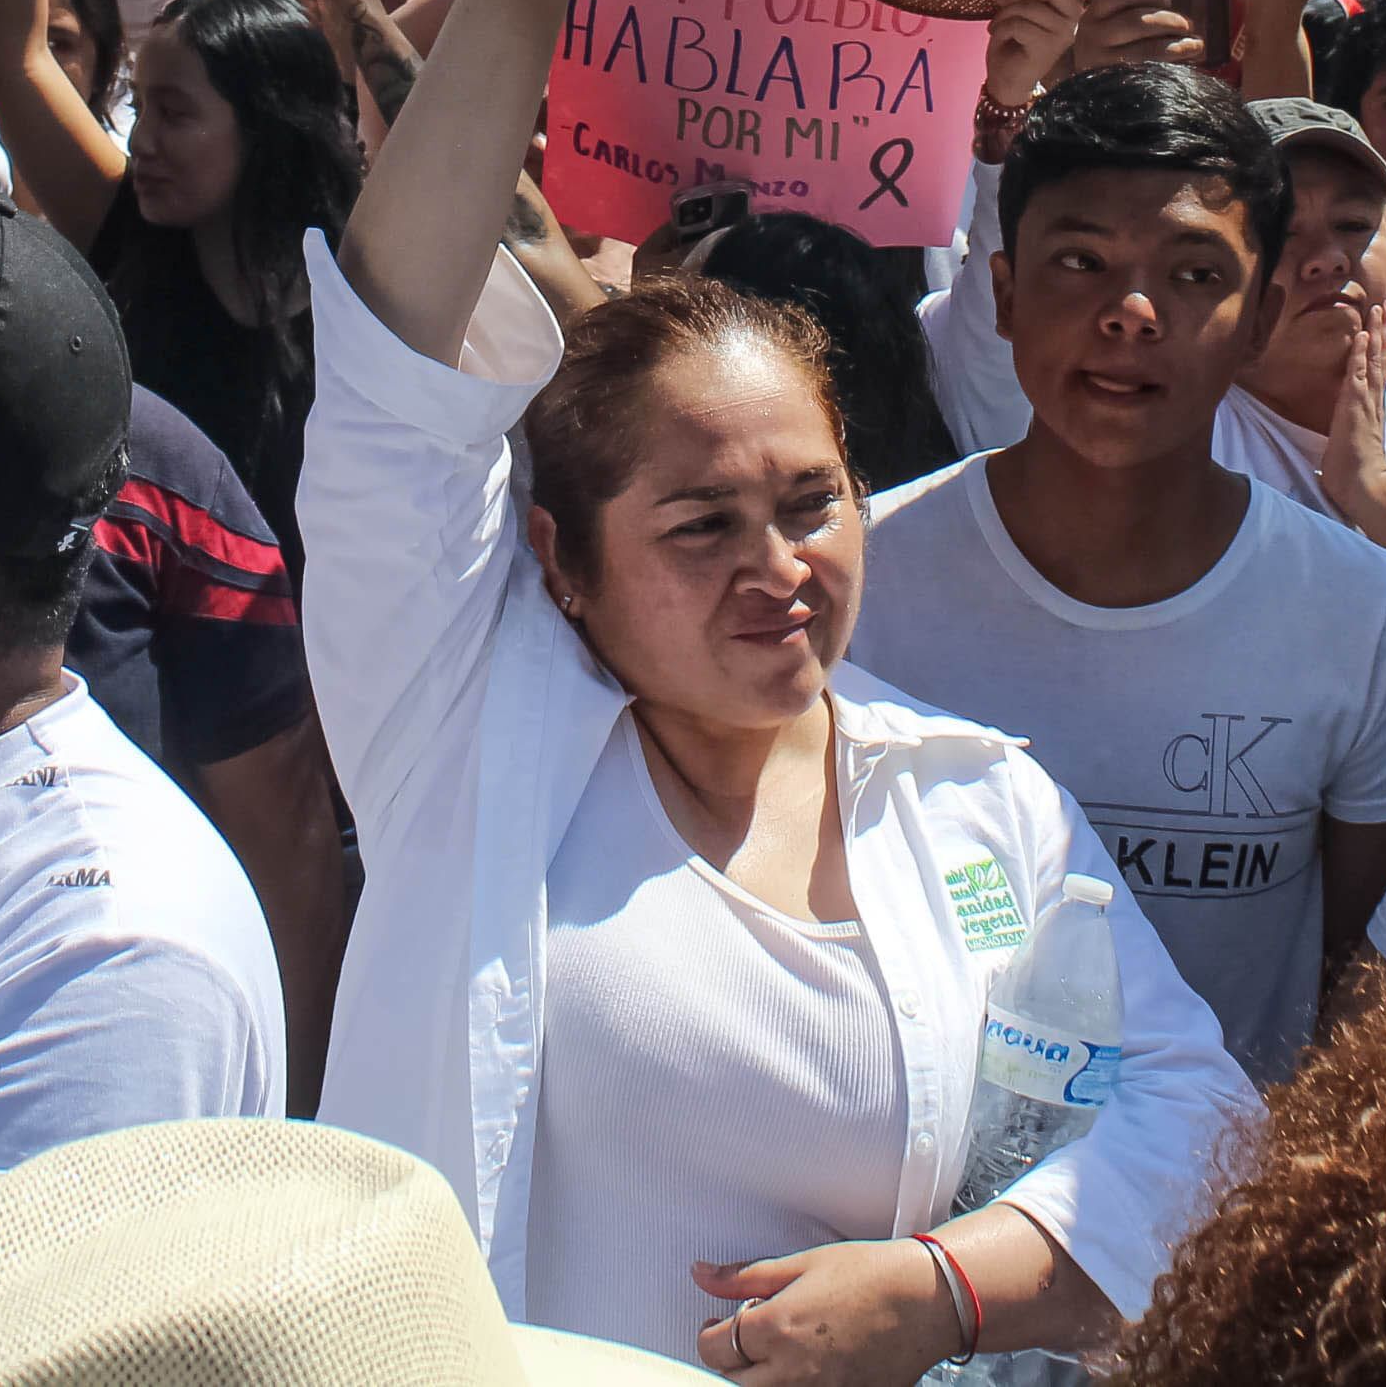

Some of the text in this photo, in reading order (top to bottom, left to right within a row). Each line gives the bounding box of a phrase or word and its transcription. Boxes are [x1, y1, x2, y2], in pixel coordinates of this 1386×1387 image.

[675, 98, 762, 156] POR
[694, 157, 810, 199] MNZO
[1117, 836, 1281, 890] KLEIN
